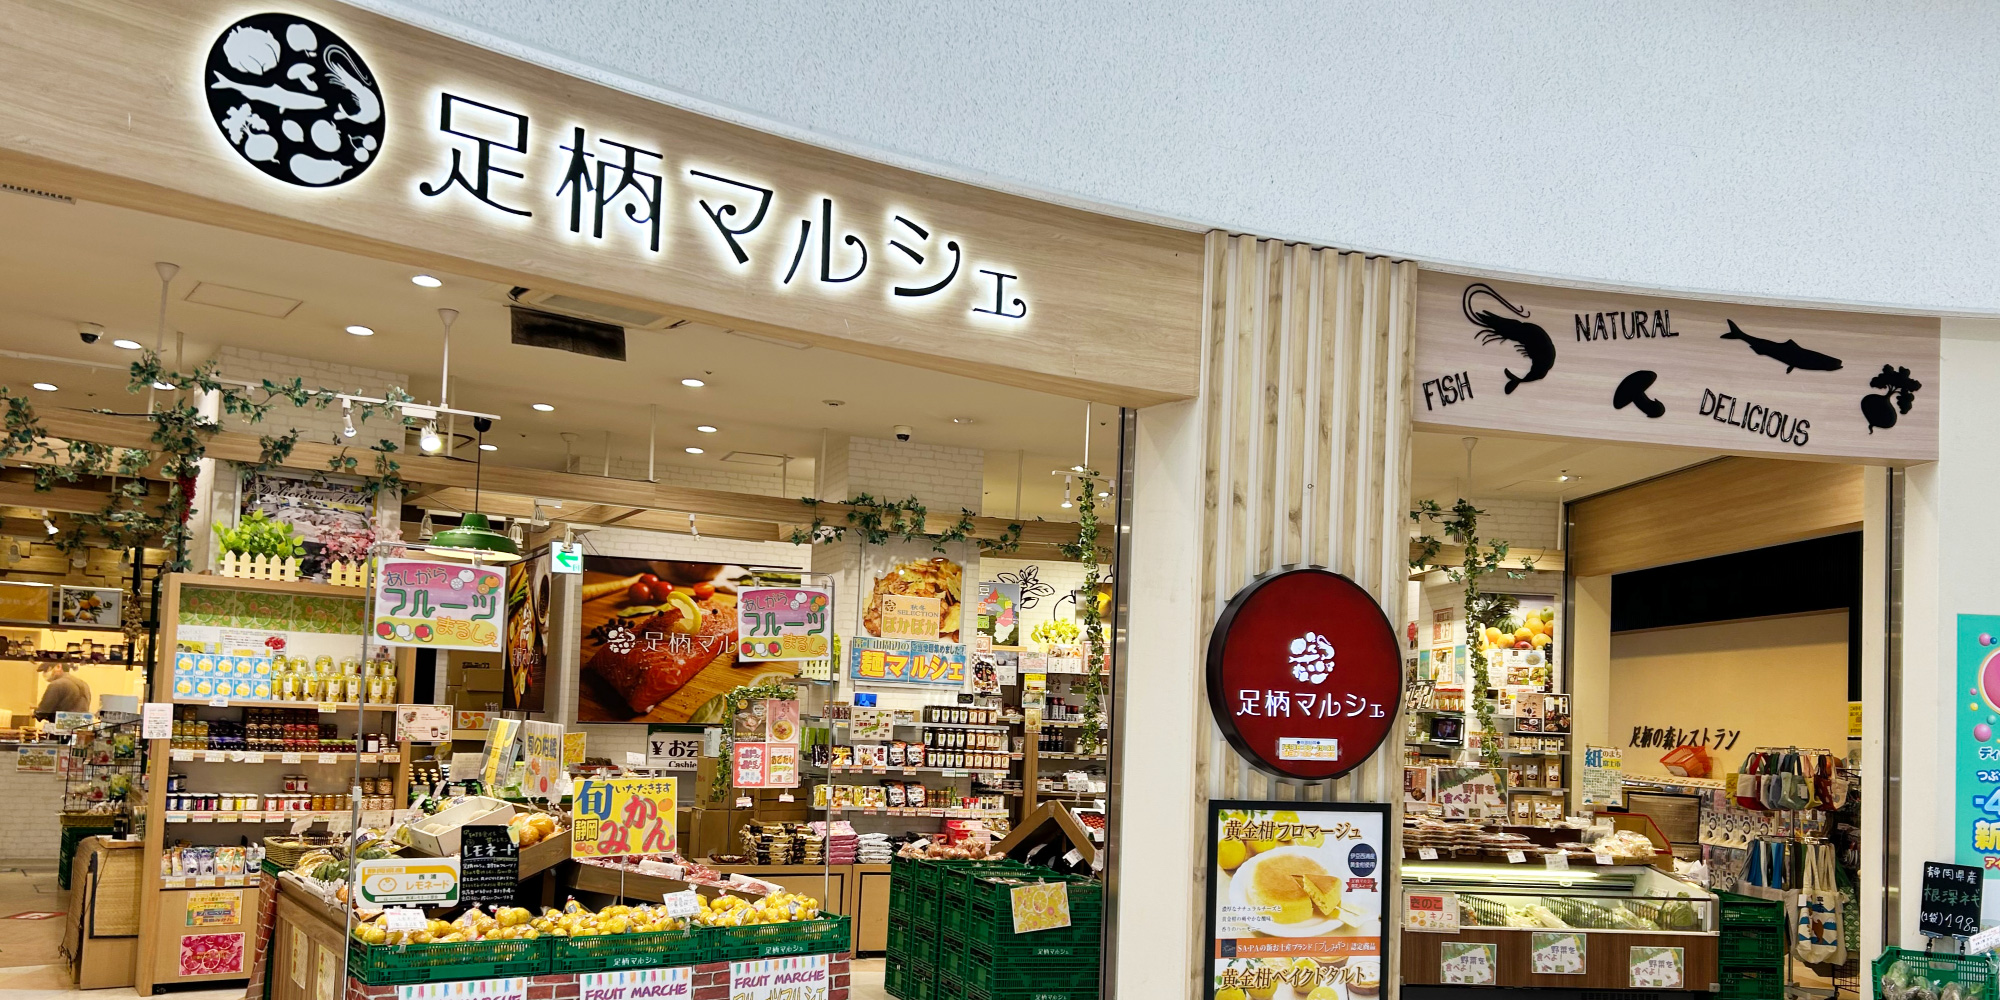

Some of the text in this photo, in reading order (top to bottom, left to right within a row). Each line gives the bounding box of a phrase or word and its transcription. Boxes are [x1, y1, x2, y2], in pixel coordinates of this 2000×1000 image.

[418, 91, 1027, 320] 足柄マルシェ
[1574, 309, 1679, 342] NATURAL
[1422, 371, 1473, 411] FISH
[1699, 387, 1810, 446] DELICIOUS
[387, 567, 448, 587] あしがら
[384, 588, 496, 621] フルーツ
[744, 592, 788, 612] あしがら
[897, 609, 939, 618] SELECTION
[436, 615, 499, 648] まるしぇ
[744, 612, 825, 636] フルーツ
[782, 632, 829, 656] まるしぇ
[859, 649, 965, 681] 麺マルシェ
[1236, 689, 1385, 719] 足柄マルシェ
[1629, 726, 1741, 750] 足柄の森レストラン
[1977, 770, 2000, 782] つぶ
[615, 783, 671, 794] いただきます
[575, 781, 614, 820] 旬
[574, 819, 599, 842] 静岡
[597, 794, 676, 854] みかん
[1225, 820, 1362, 841] 黄金柑フロマージュ
[464, 843, 520, 857] レモネード
[405, 879, 449, 890] レモネード
[1927, 865, 1977, 884] 静岡県産
[1410, 898, 1442, 910] きのこ
[1924, 884, 1981, 908] 根深ネギ
[1430, 912, 1453, 920] キノコ
[764, 944, 804, 955] 足柄マルシェ
[1550, 946, 1576, 955] 野菜を
[612, 956, 658, 967] 足柄マルシェ
[1460, 956, 1485, 965] 野菜を
[1649, 960, 1673, 968] 野菜を
[735, 969, 826, 989] FRUIT MARCHE
[1221, 966, 1366, 990] 黄金柑ベイクドタルト
[585, 983, 688, 1000] FRUIT MARCHE
